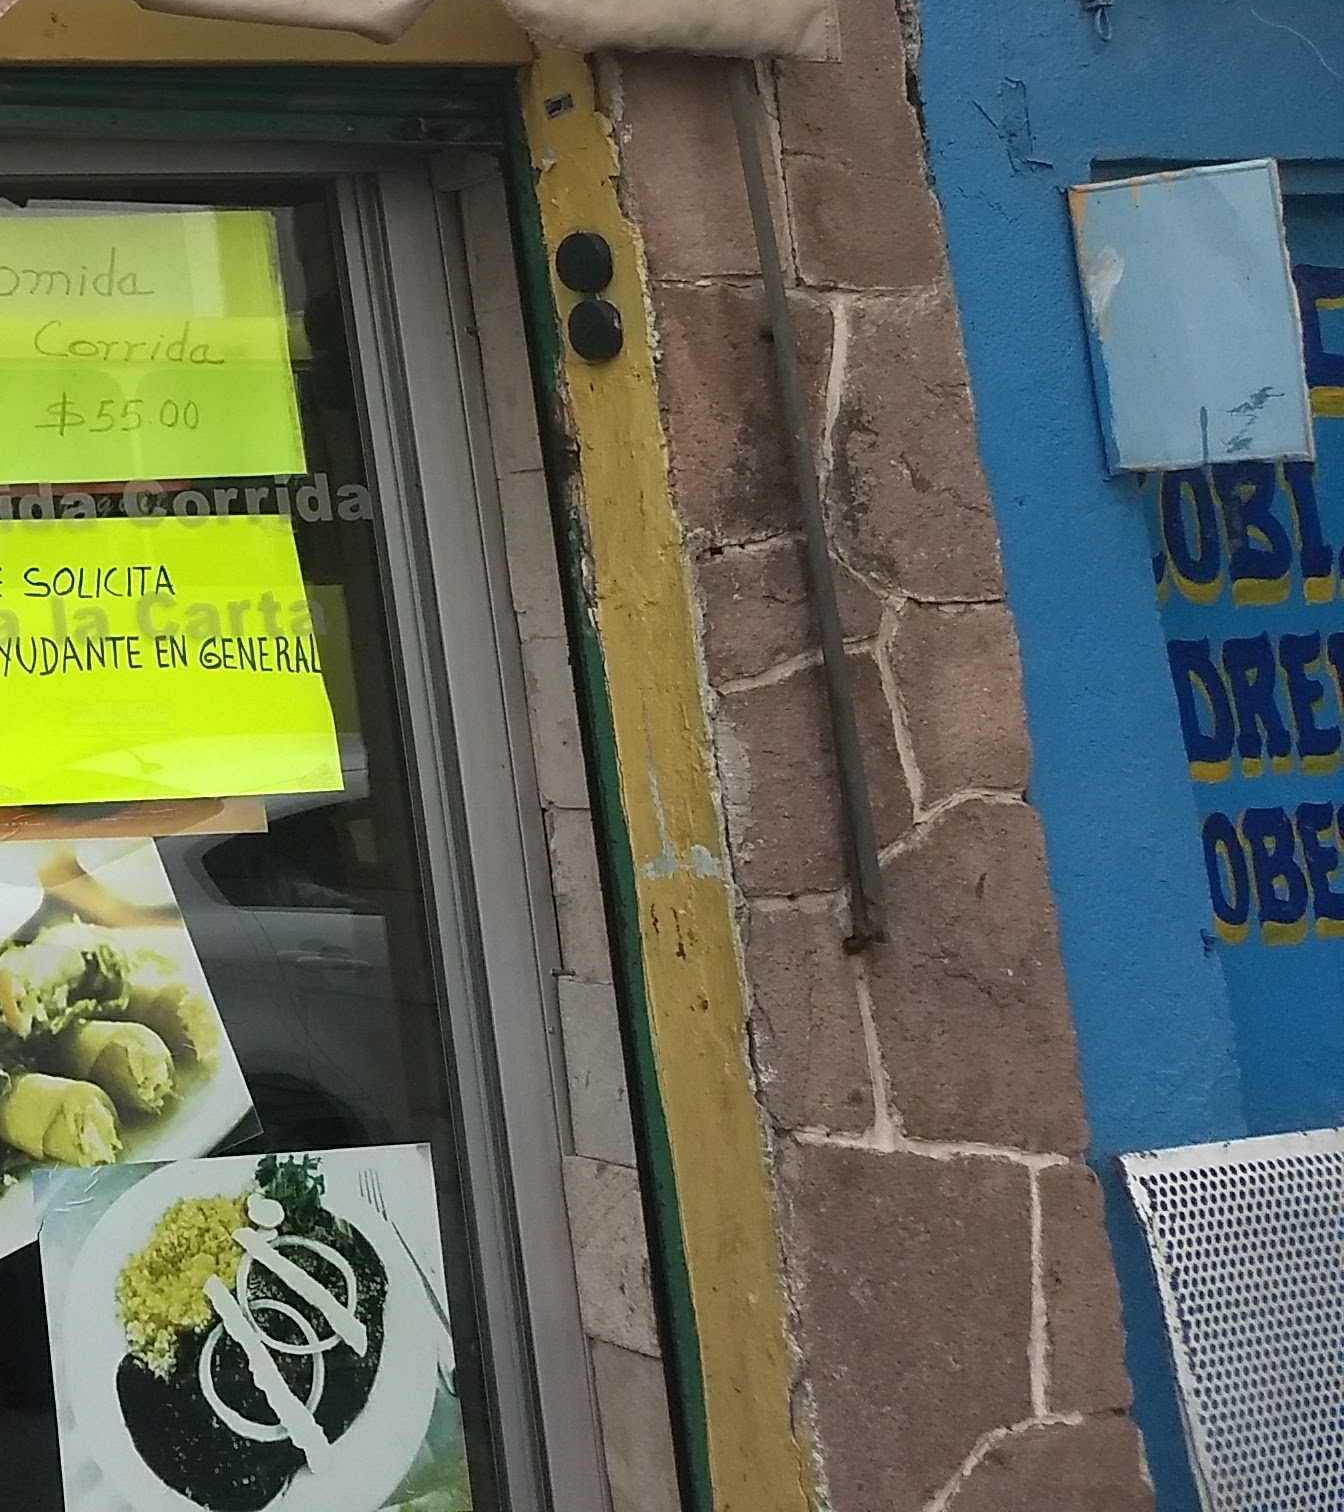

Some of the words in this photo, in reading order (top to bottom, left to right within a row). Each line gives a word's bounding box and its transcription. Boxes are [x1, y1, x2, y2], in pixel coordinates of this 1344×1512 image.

[34, 320, 226, 366] Corrida
[35, 391, 200, 437] $55.00
[124, 472, 375, 528] Corrida
[23, 564, 177, 598] SOLICITA
[136, 590, 326, 643] Carta
[157, 634, 188, 669] EN
[199, 634, 323, 673] GENERAL
